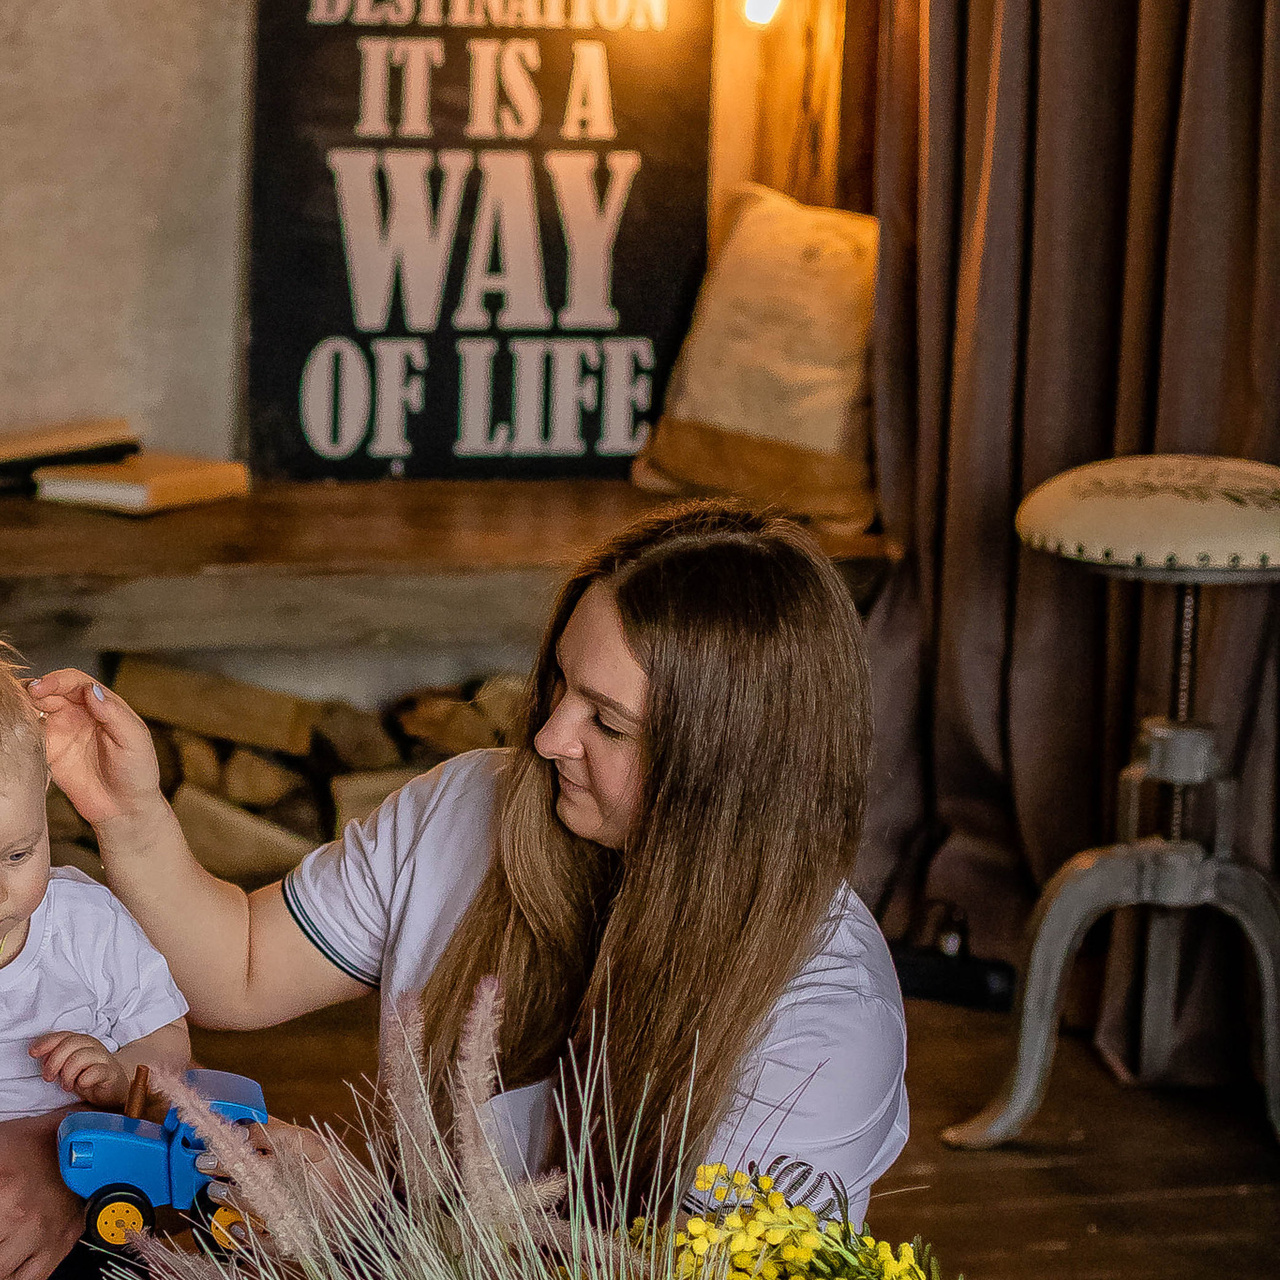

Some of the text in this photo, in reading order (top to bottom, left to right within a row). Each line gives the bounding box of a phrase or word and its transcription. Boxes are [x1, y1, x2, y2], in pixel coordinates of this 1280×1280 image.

[354, 36, 618, 140] IT IS A
[325, 148, 642, 333] WAY
[299, 335, 655, 459] OF LIFE
